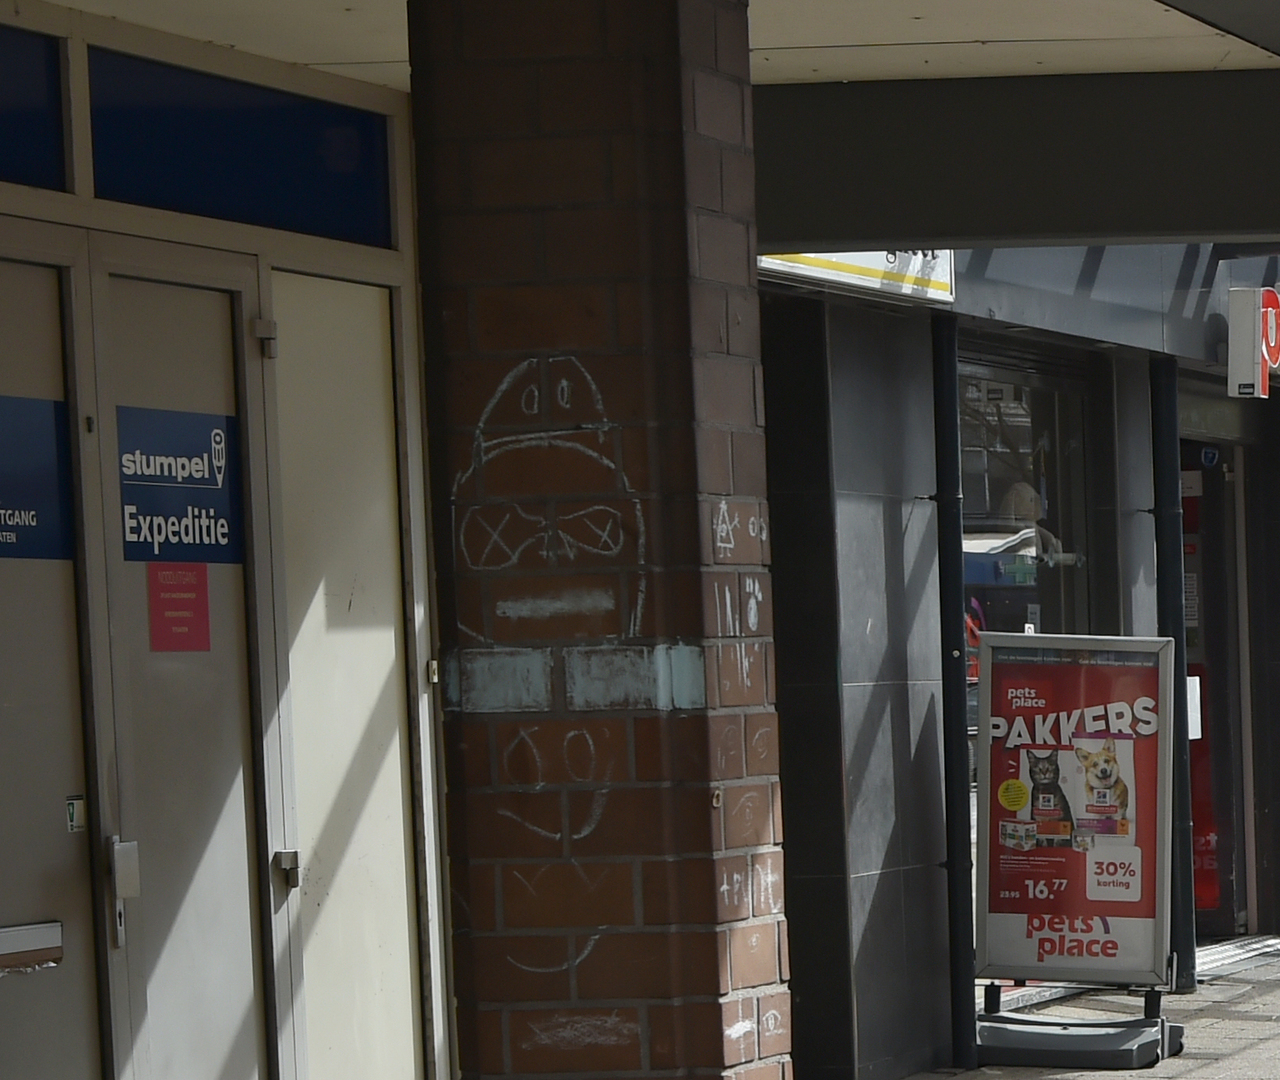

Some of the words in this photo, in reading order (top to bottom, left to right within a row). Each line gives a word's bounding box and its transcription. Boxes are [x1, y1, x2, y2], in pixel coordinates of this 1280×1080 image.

[121, 449, 210, 482] stumpel
[124, 505, 229, 554] Expeditie
[1008, 687, 1037, 699] pets
[1012, 697, 1046, 709] place
[990, 697, 1158, 749] PAKKERS
[1094, 861, 1136, 877] 30%
[1097, 879, 1130, 889] korting
[1026, 914, 1094, 938] pets
[1037, 934, 1119, 962] place
